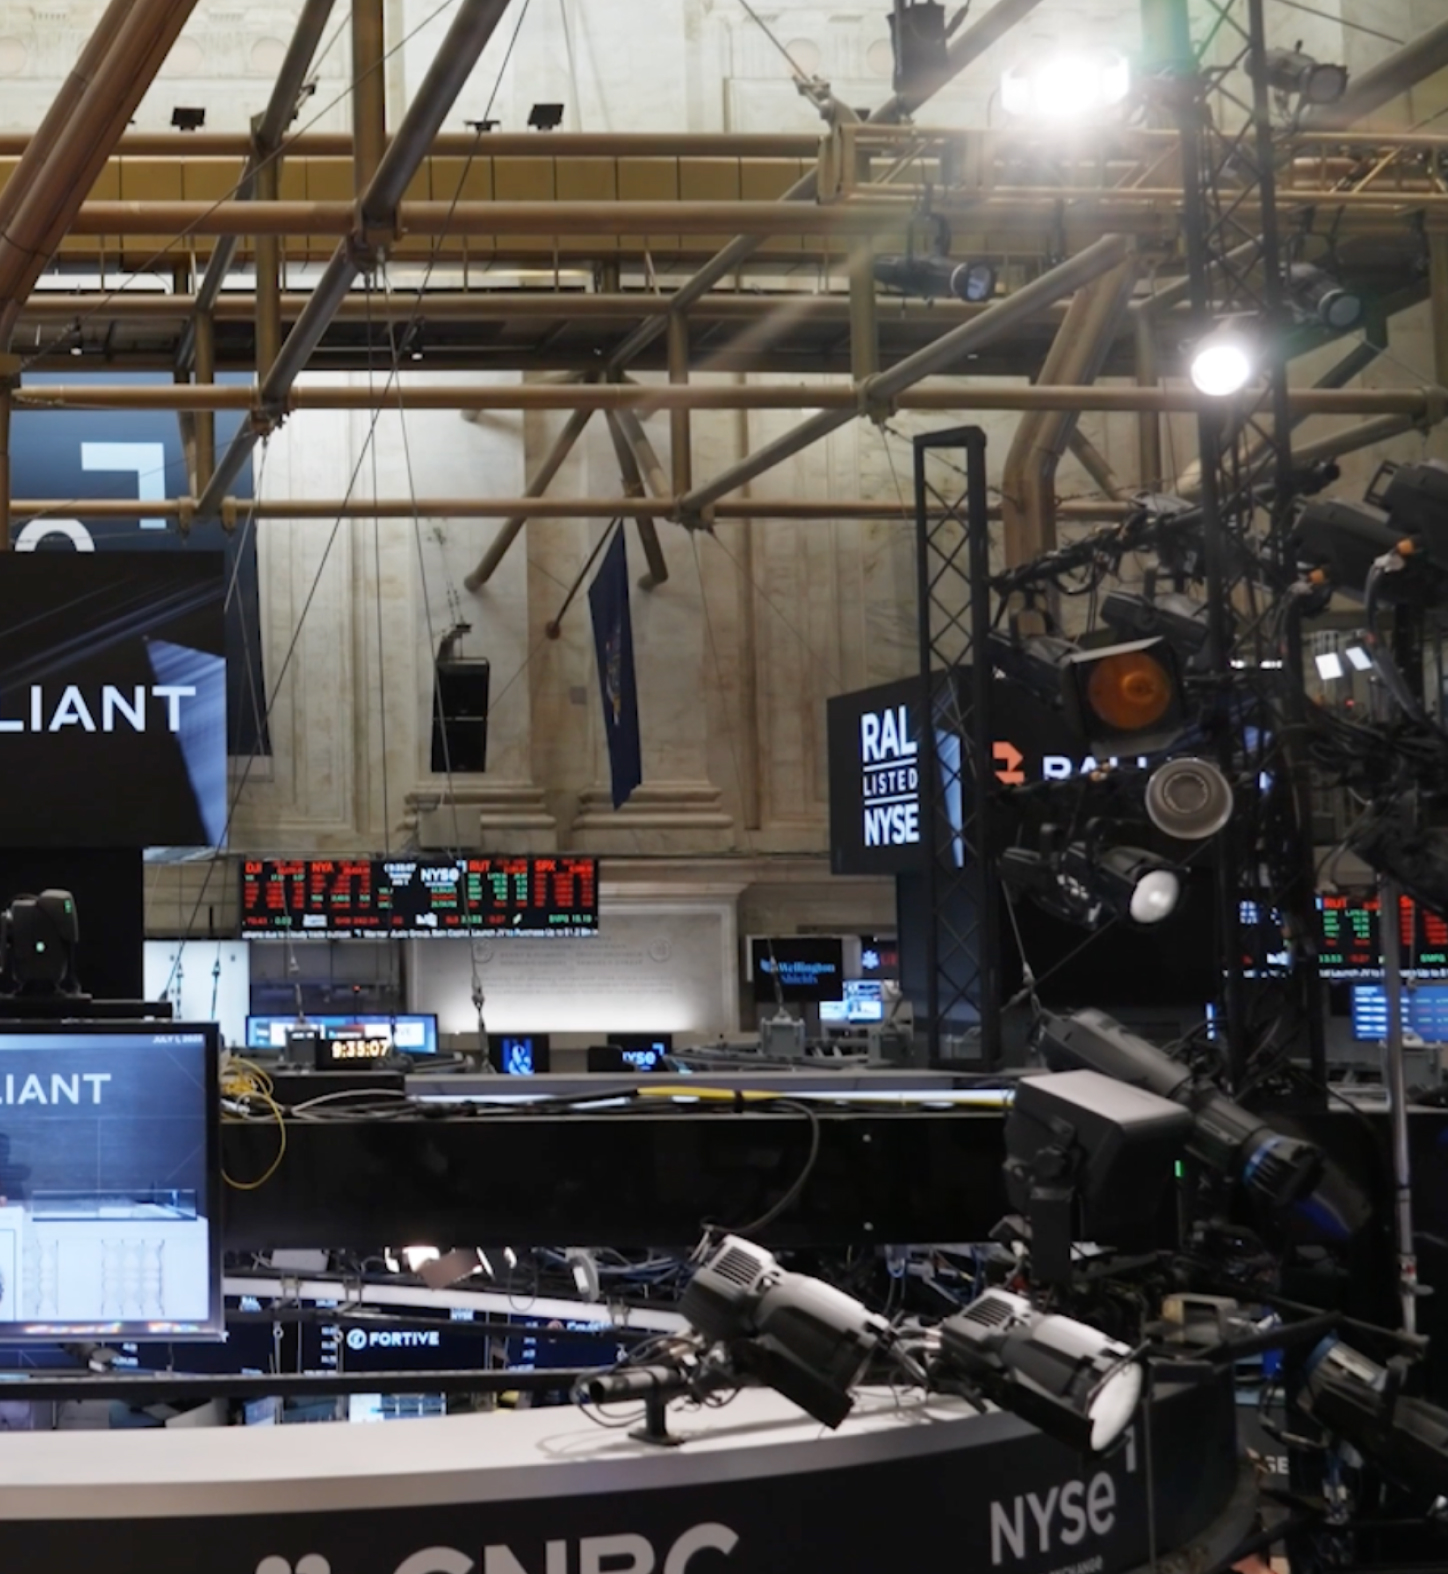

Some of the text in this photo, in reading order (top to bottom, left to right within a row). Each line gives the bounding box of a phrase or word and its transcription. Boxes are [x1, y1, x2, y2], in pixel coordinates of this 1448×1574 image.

[860, 705, 918, 764] RAL
[862, 768, 919, 797] LISTED
[863, 803, 920, 847] NYSE
[312, 861, 334, 873] NYA
[468, 860, 490, 871] RUT
[535, 860, 556, 871] SPX
[331, 1041, 388, 1059] 9:35:07
[369, 1331, 440, 1346] FORTIVE
